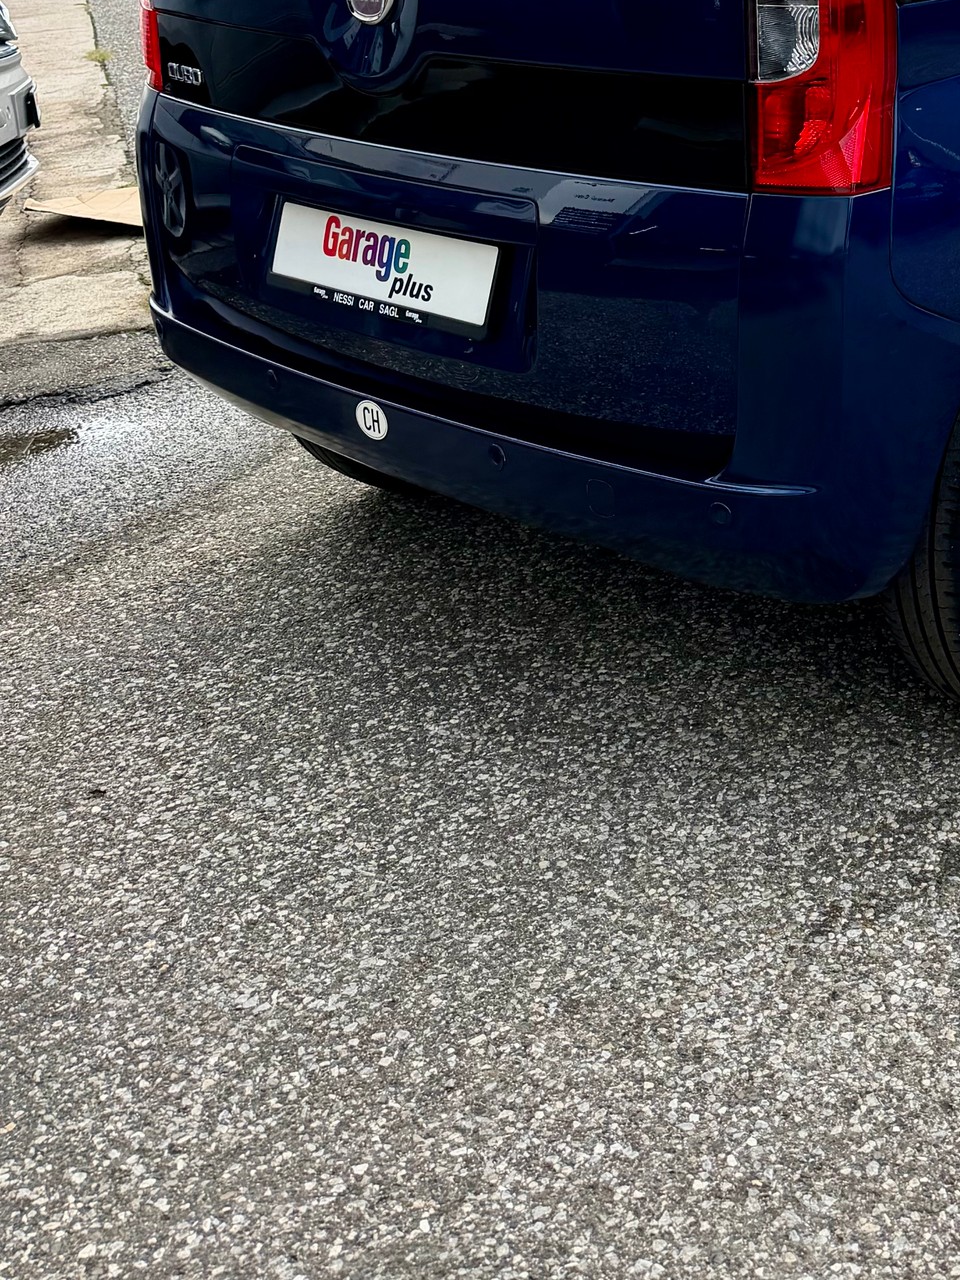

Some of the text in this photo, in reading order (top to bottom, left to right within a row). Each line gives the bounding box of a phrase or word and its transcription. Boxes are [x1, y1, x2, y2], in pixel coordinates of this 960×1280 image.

[322, 215, 411, 282] Garage
[387, 273, 434, 302] plus
[333, 291, 399, 318] NESSI CAR SAGL
[362, 406, 381, 434] CH
